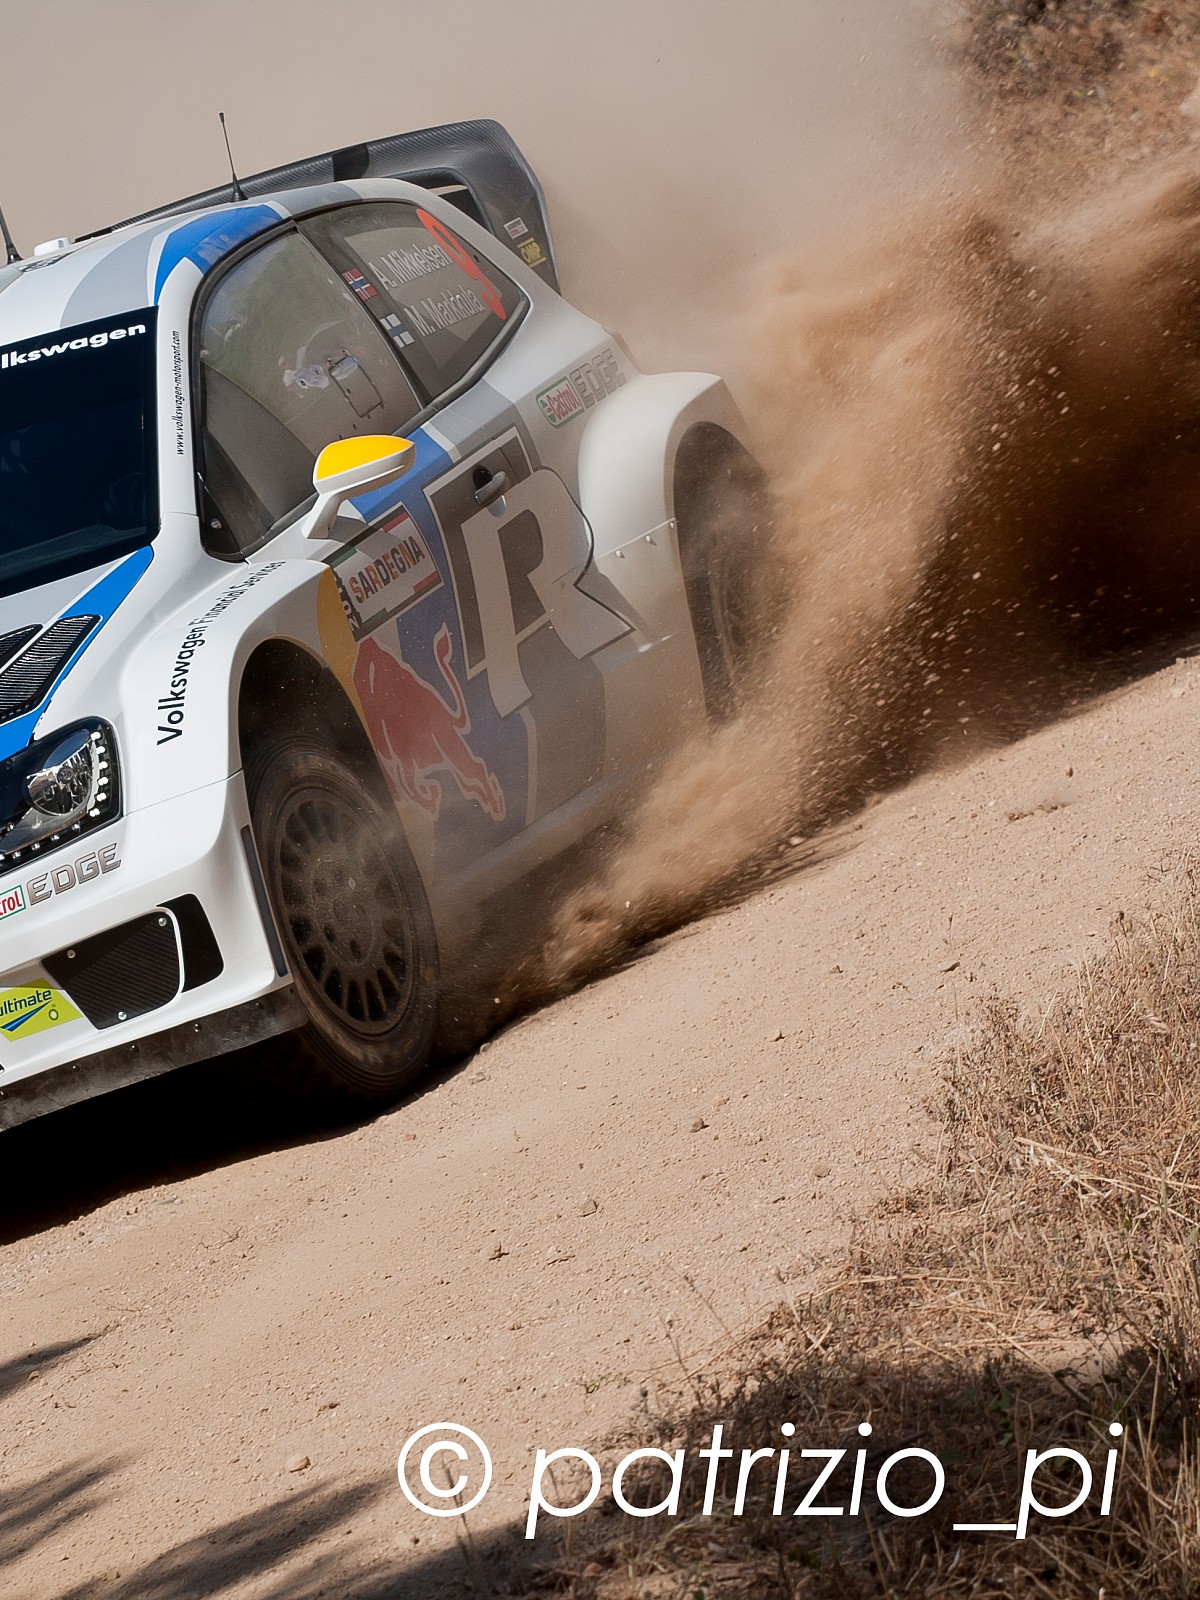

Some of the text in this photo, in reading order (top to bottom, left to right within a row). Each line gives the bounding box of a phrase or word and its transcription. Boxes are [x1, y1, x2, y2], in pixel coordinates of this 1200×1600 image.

[368, 243, 453, 291] A. Mikkelsen
[403, 304, 436, 337] M.
[171, 330, 186, 456] www.volkswagen-motorsport.com
[568, 348, 628, 410] EDGE
[348, 535, 426, 604] SARDEGNA
[156, 625, 208, 746] Volkswagen
[188, 590, 248, 626] Financial
[26, 842, 122, 907] EDGE
